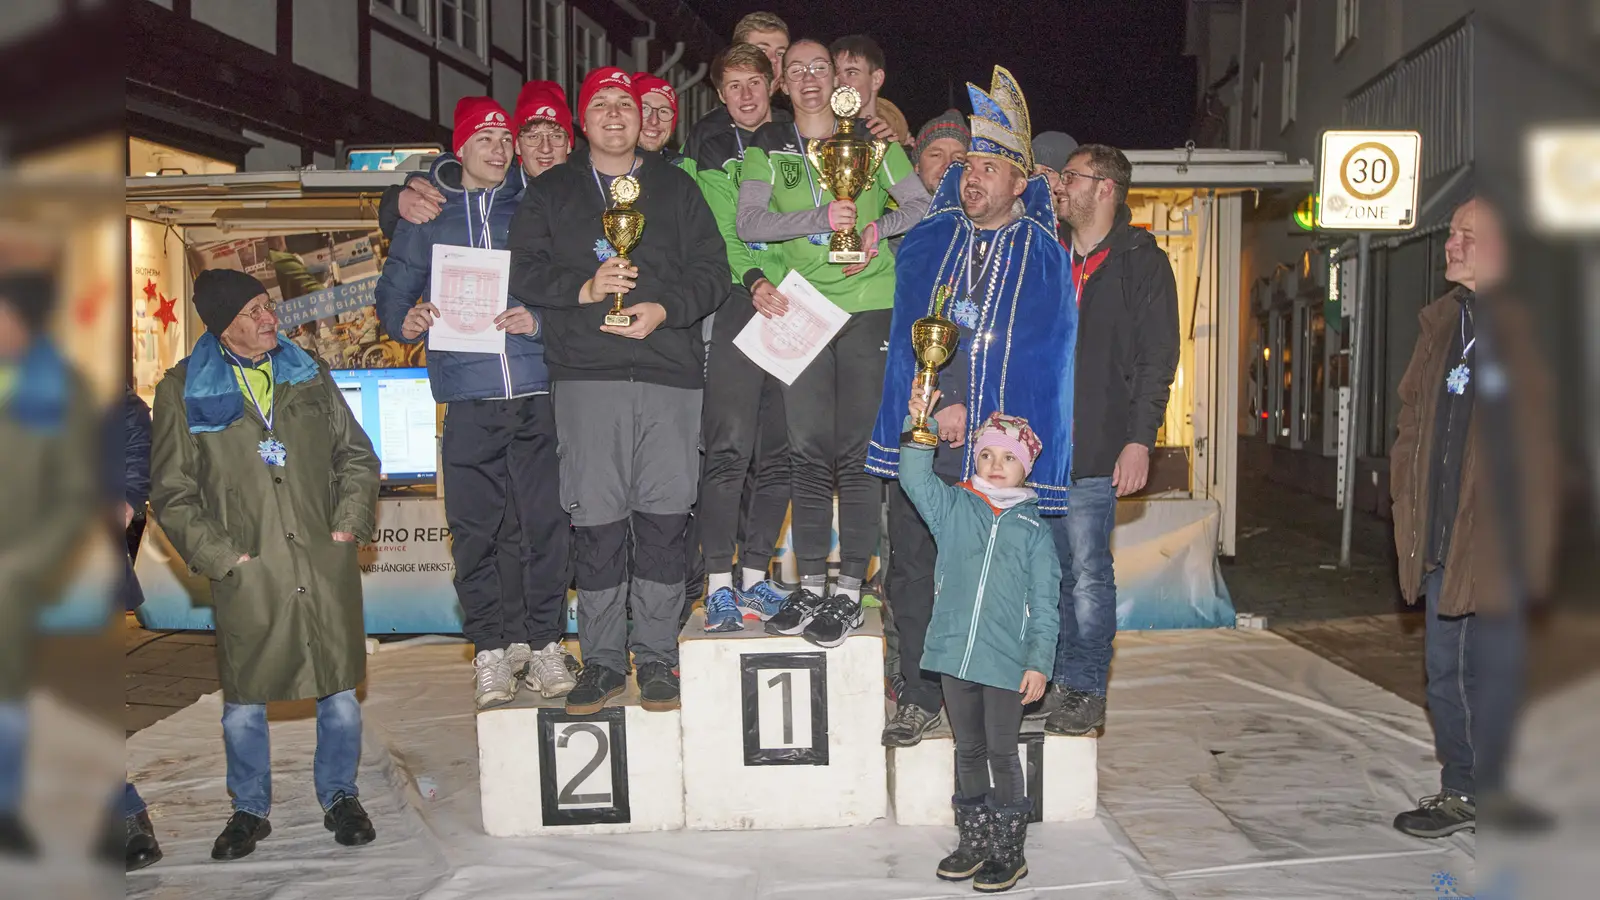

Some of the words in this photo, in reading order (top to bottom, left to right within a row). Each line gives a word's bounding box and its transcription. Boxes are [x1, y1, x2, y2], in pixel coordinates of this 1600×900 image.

[1352, 158, 1387, 184] 30
[1345, 205, 1390, 219] ZONE
[278, 300, 305, 314] TEIL
[310, 292, 335, 305] DER
[341, 280, 376, 297] COMM
[414, 527, 454, 542] REP
[767, 672, 793, 744] 1
[556, 723, 612, 805] 2
